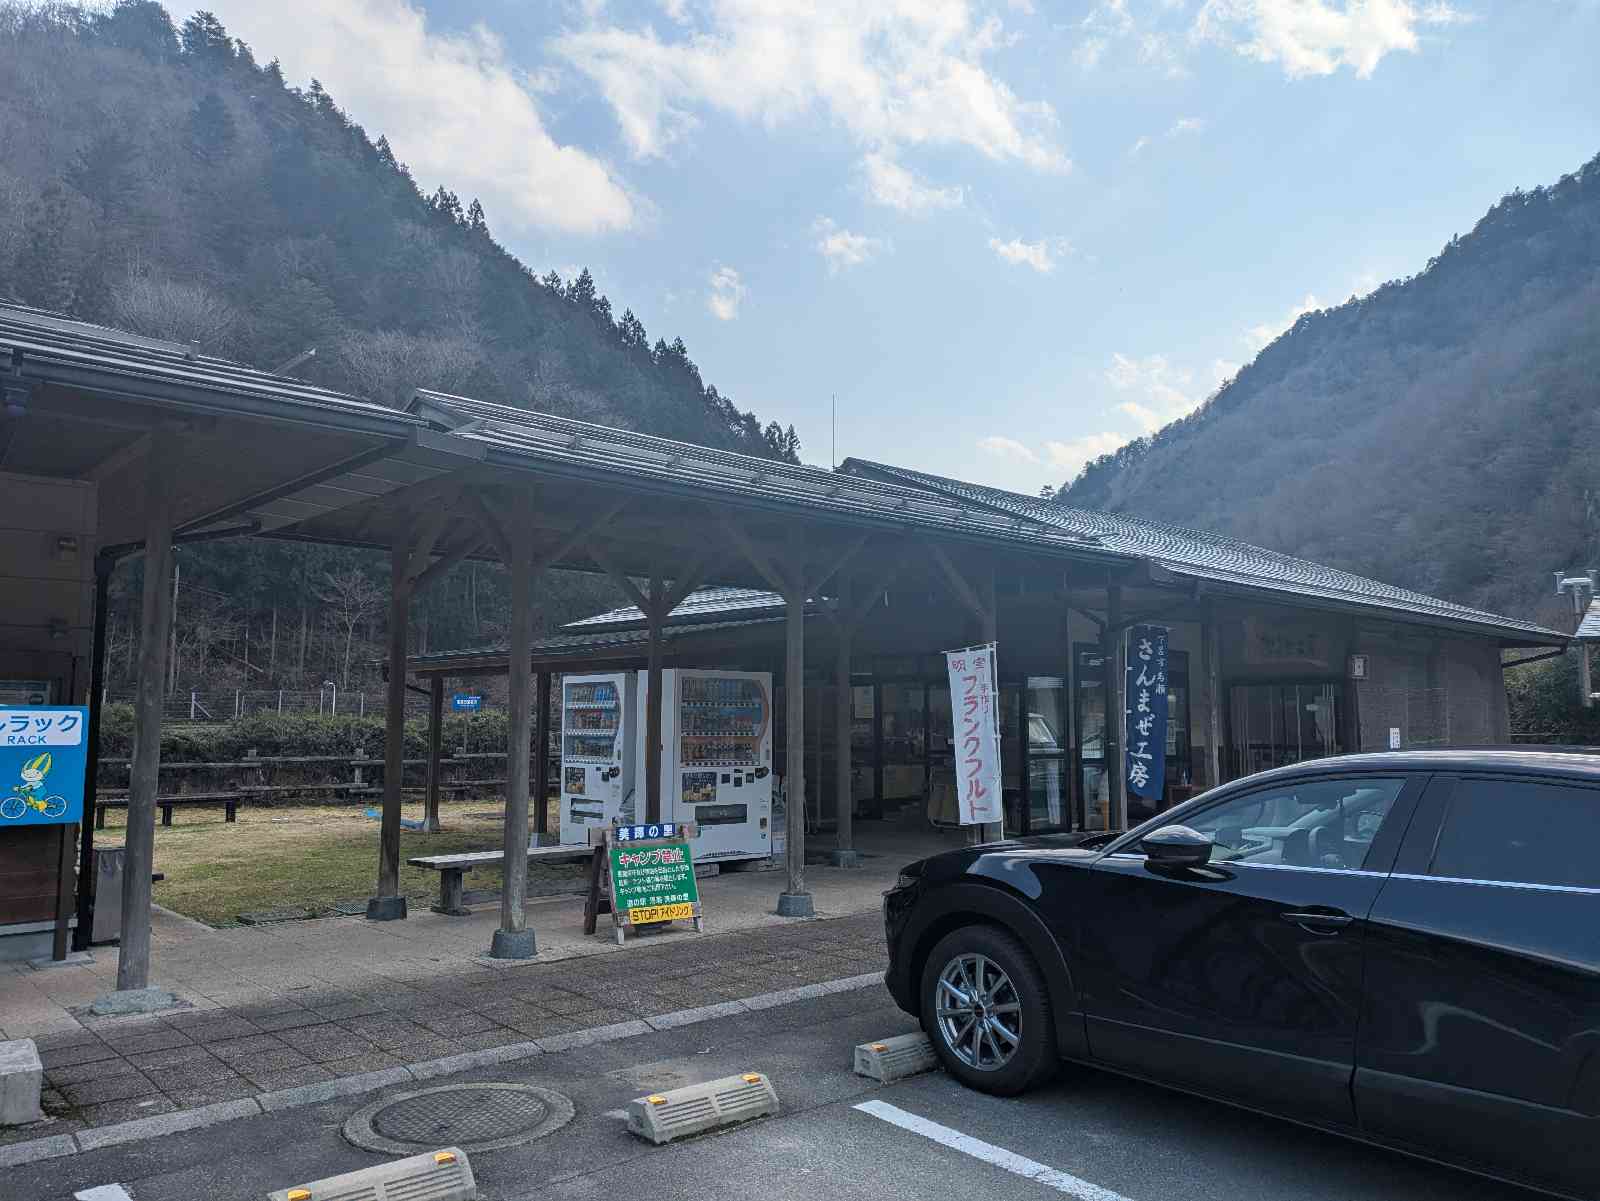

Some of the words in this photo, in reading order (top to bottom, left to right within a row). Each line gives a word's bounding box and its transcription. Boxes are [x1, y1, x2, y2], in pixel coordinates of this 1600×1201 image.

[1128, 637, 1156, 788] さんまぜ工房
[0, 714, 79, 733] ラック
[7, 735, 47, 745] RACK
[960, 675, 988, 819] フランクフルト
[618, 848, 686, 868] キャンプ禁止
